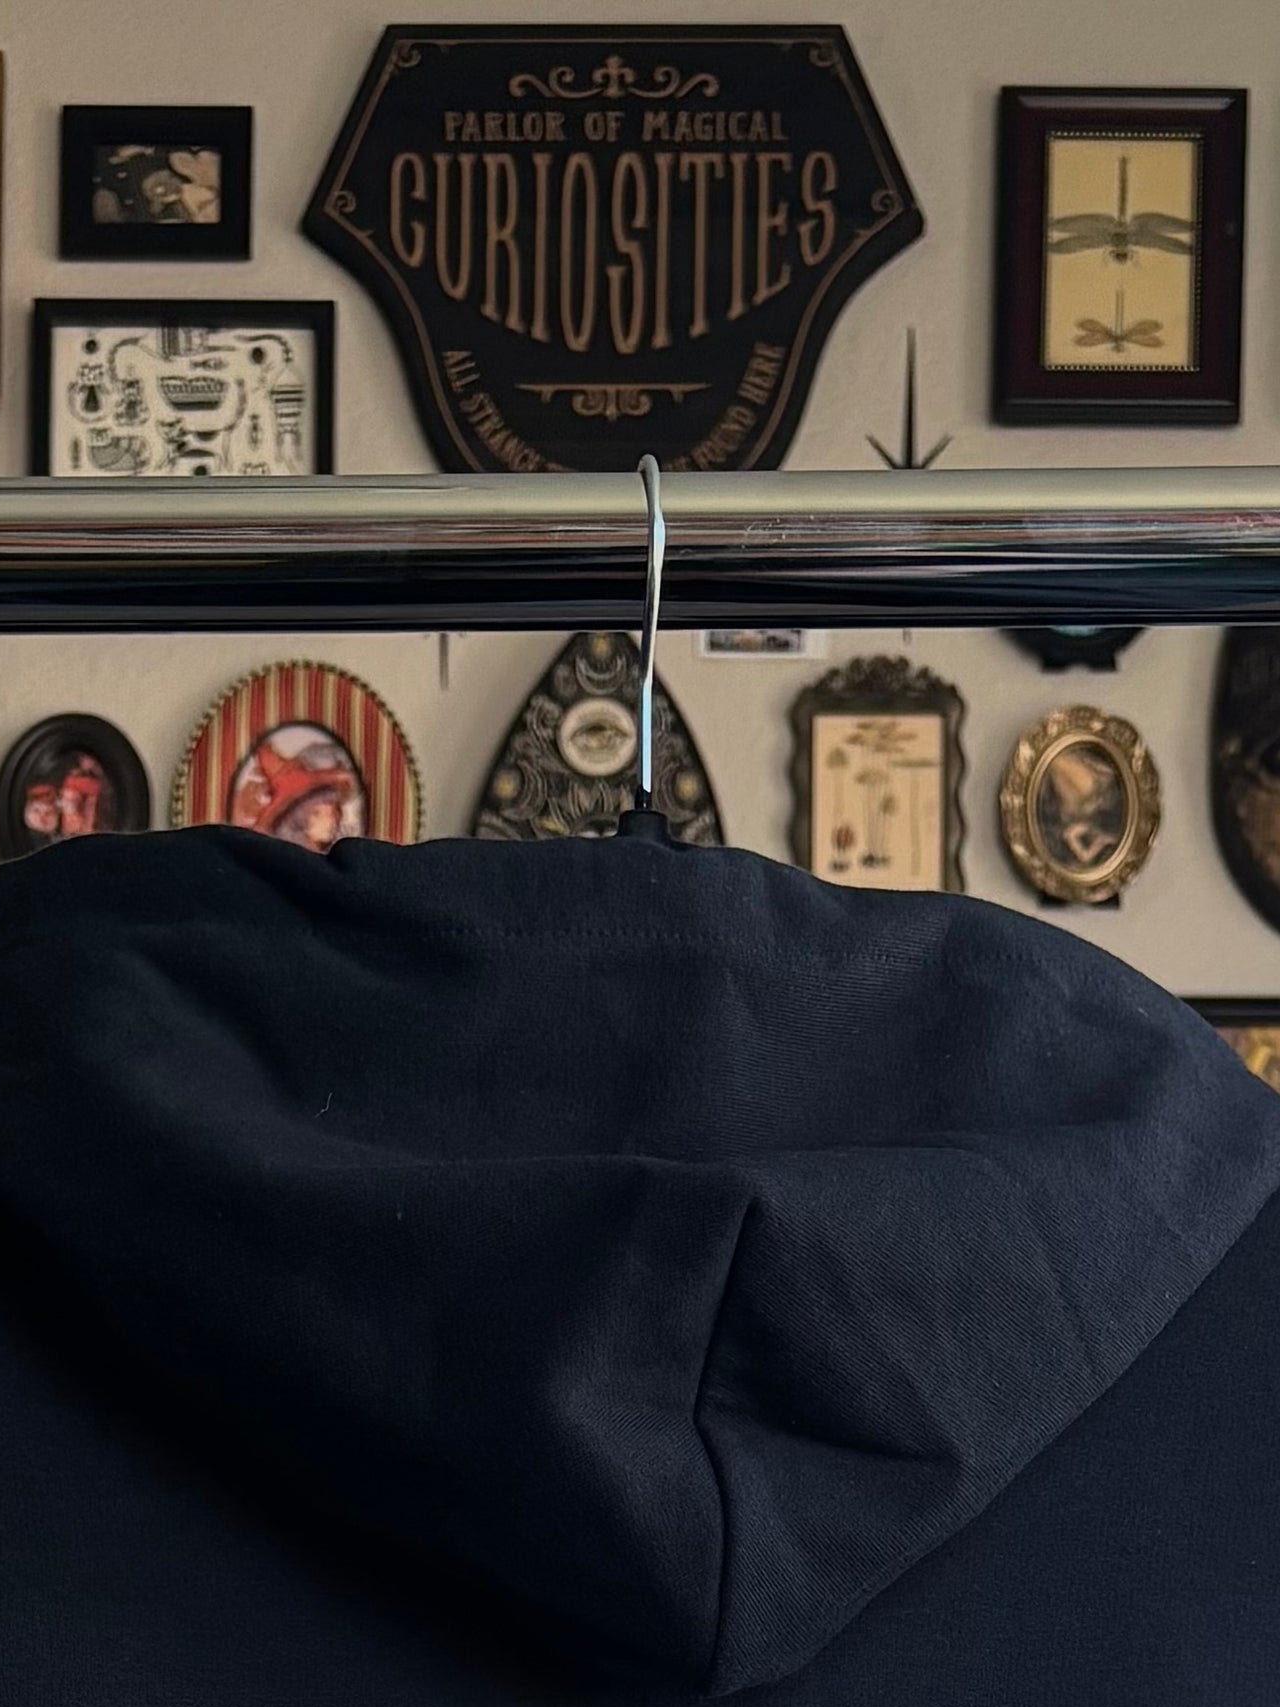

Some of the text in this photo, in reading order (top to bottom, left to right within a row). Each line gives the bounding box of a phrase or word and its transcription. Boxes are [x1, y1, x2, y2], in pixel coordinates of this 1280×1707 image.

[443, 110, 790, 143] PARLOR OF MAGICAL
[389, 150, 840, 355] CURIOSITIES
[442, 350, 480, 393] ALL
